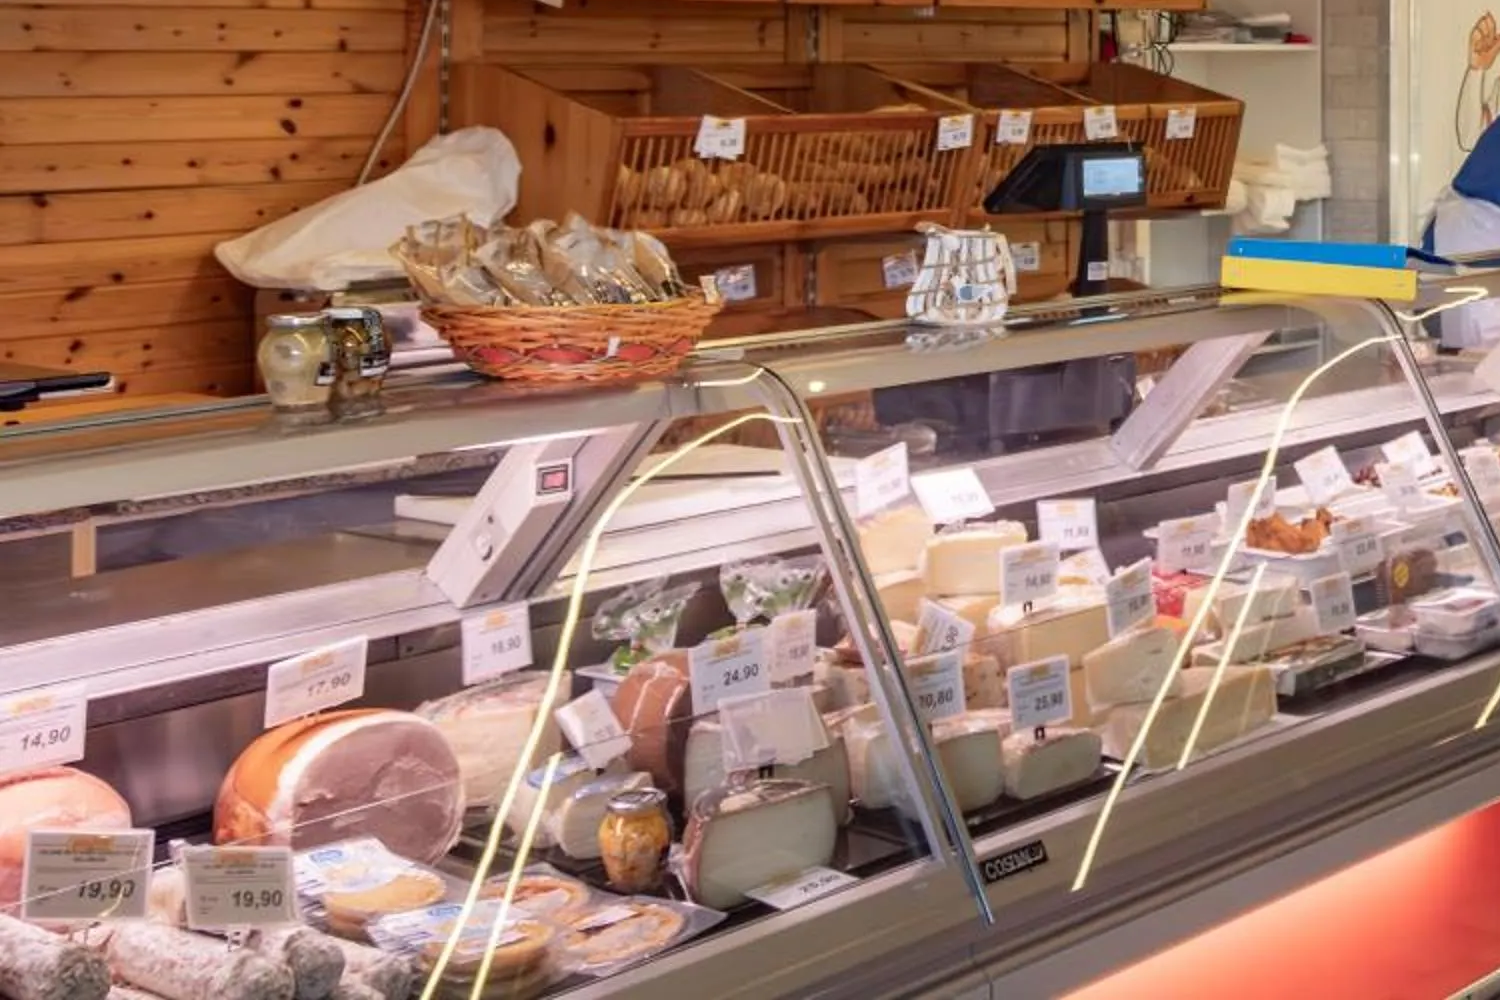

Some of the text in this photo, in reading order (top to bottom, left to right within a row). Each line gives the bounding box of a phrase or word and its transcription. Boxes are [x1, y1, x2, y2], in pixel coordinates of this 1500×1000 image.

[21, 725, 72, 751] 14,90
[78, 879, 136, 901] 19,90
[230, 888, 284, 910] 19,90
